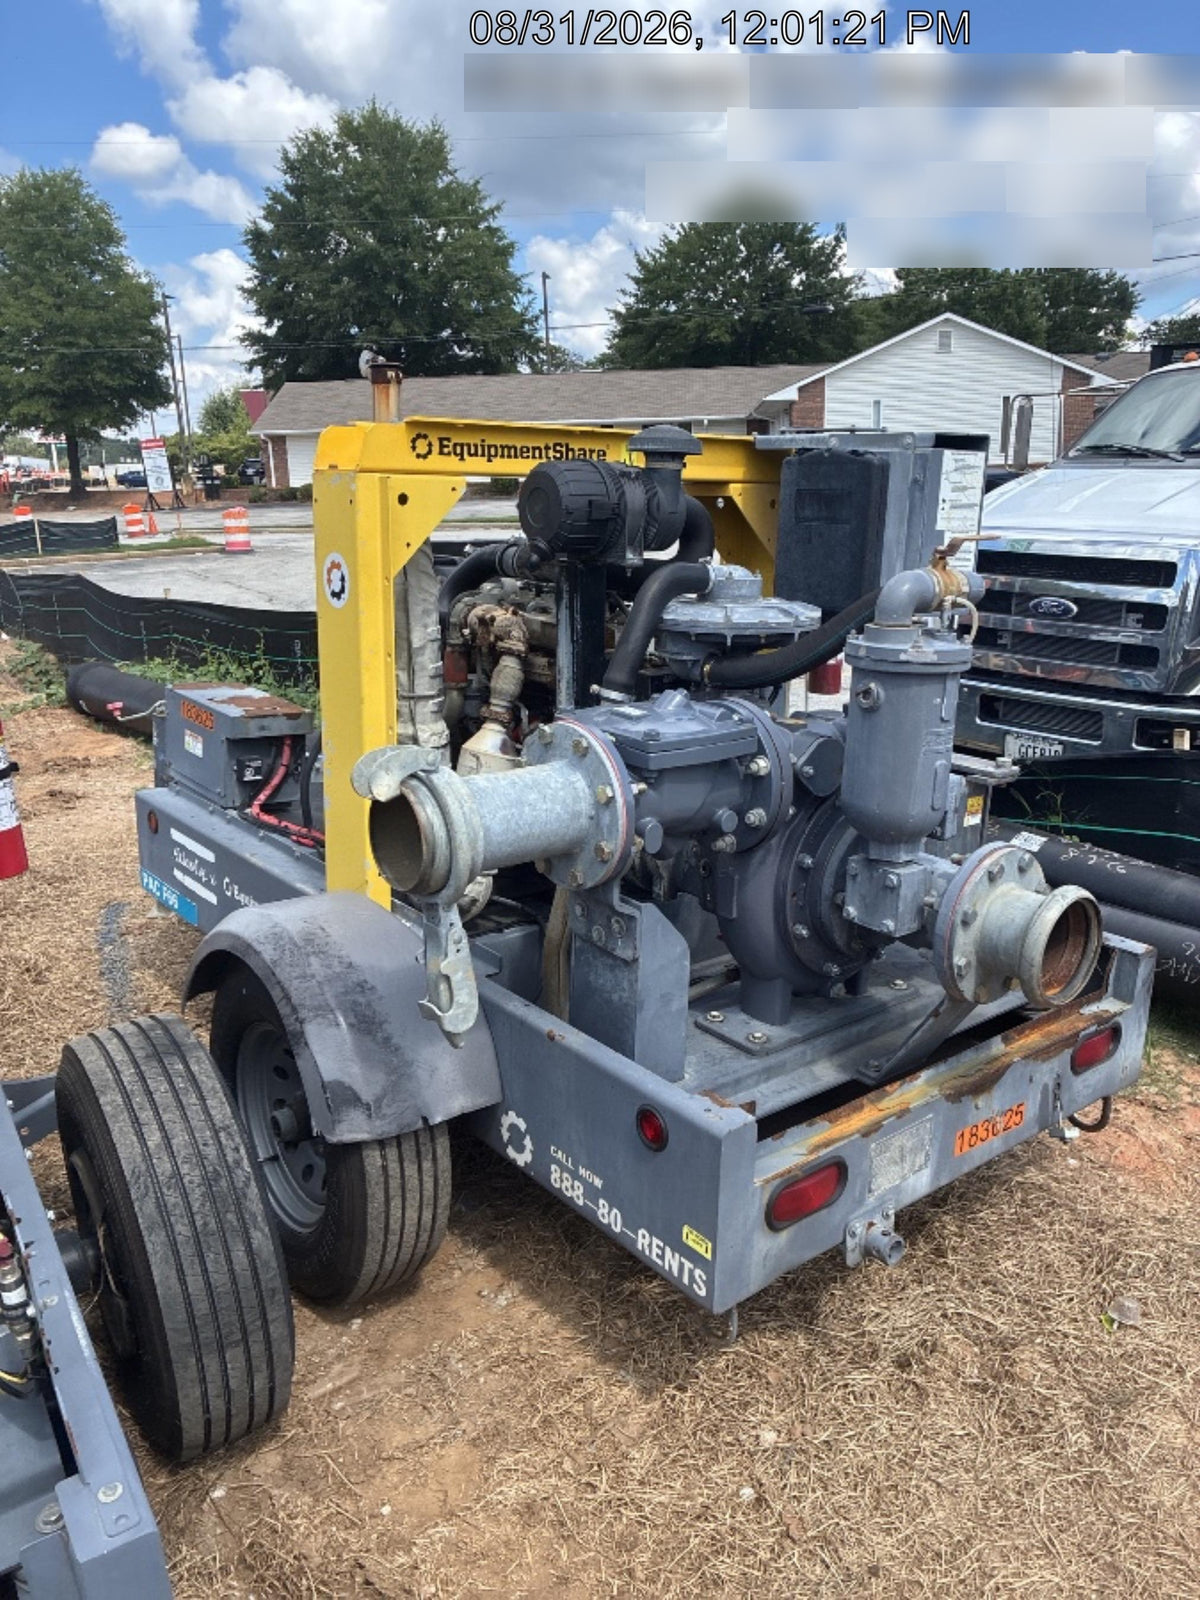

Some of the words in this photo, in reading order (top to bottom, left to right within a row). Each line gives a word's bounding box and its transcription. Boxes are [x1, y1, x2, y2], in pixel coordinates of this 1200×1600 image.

[437, 437, 607, 462] EquipmentShare
[550, 1145, 575, 1170] CALL
[578, 1165, 603, 1189] NOW
[550, 1163, 707, 1297] 888-80-RENTS
